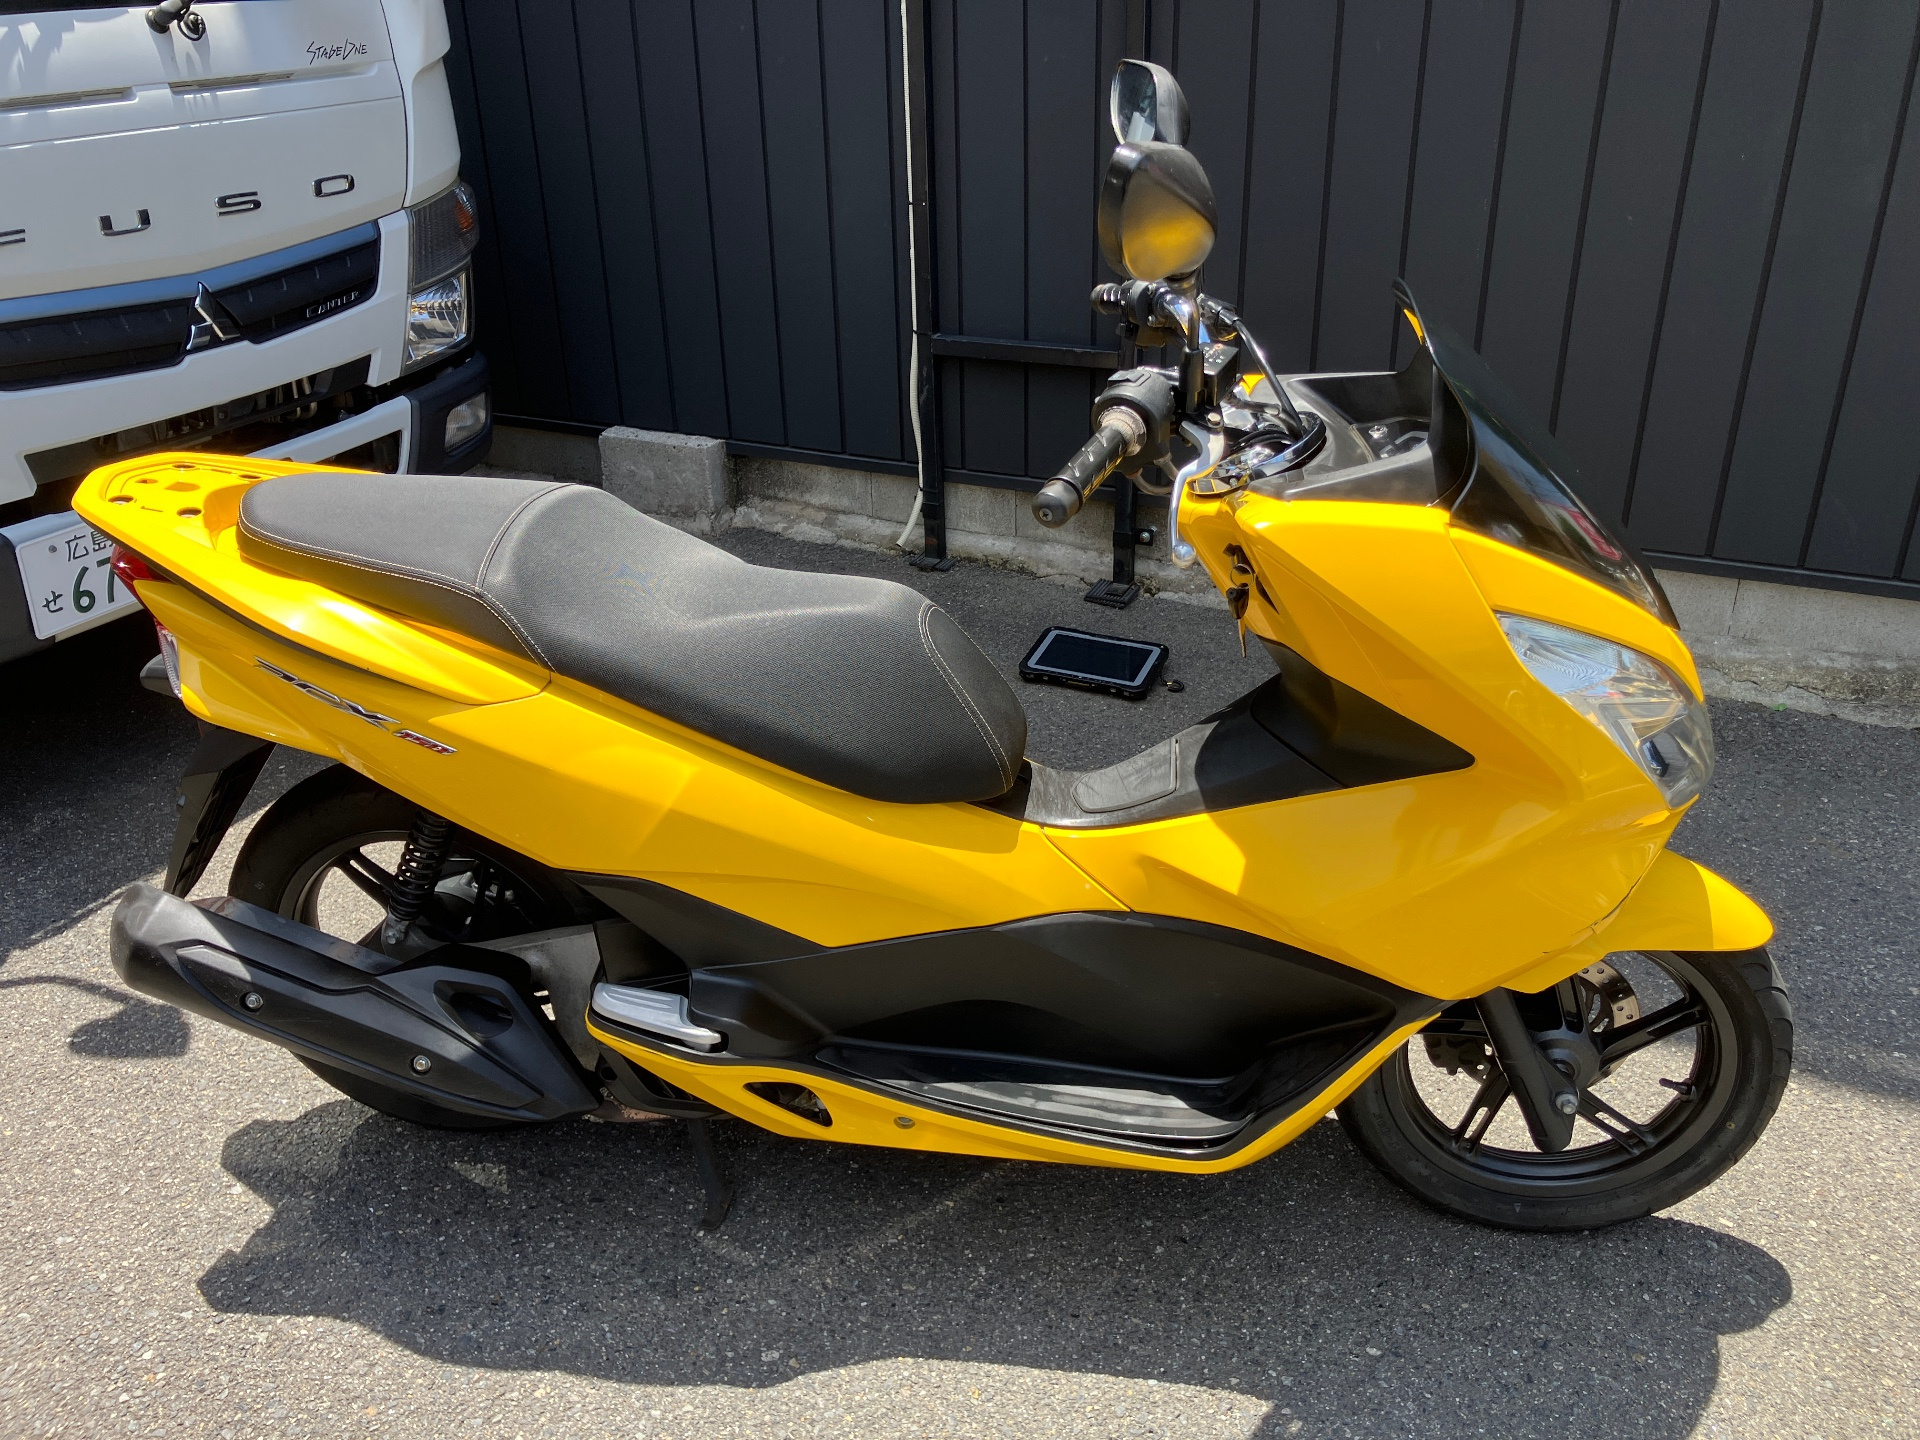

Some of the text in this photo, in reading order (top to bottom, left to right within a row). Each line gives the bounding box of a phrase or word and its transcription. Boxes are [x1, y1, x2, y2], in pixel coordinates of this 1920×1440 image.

[306, 291, 360, 318] CANTER
[42, 590, 64, 613] せ
[253, 655, 401, 732] PCX
